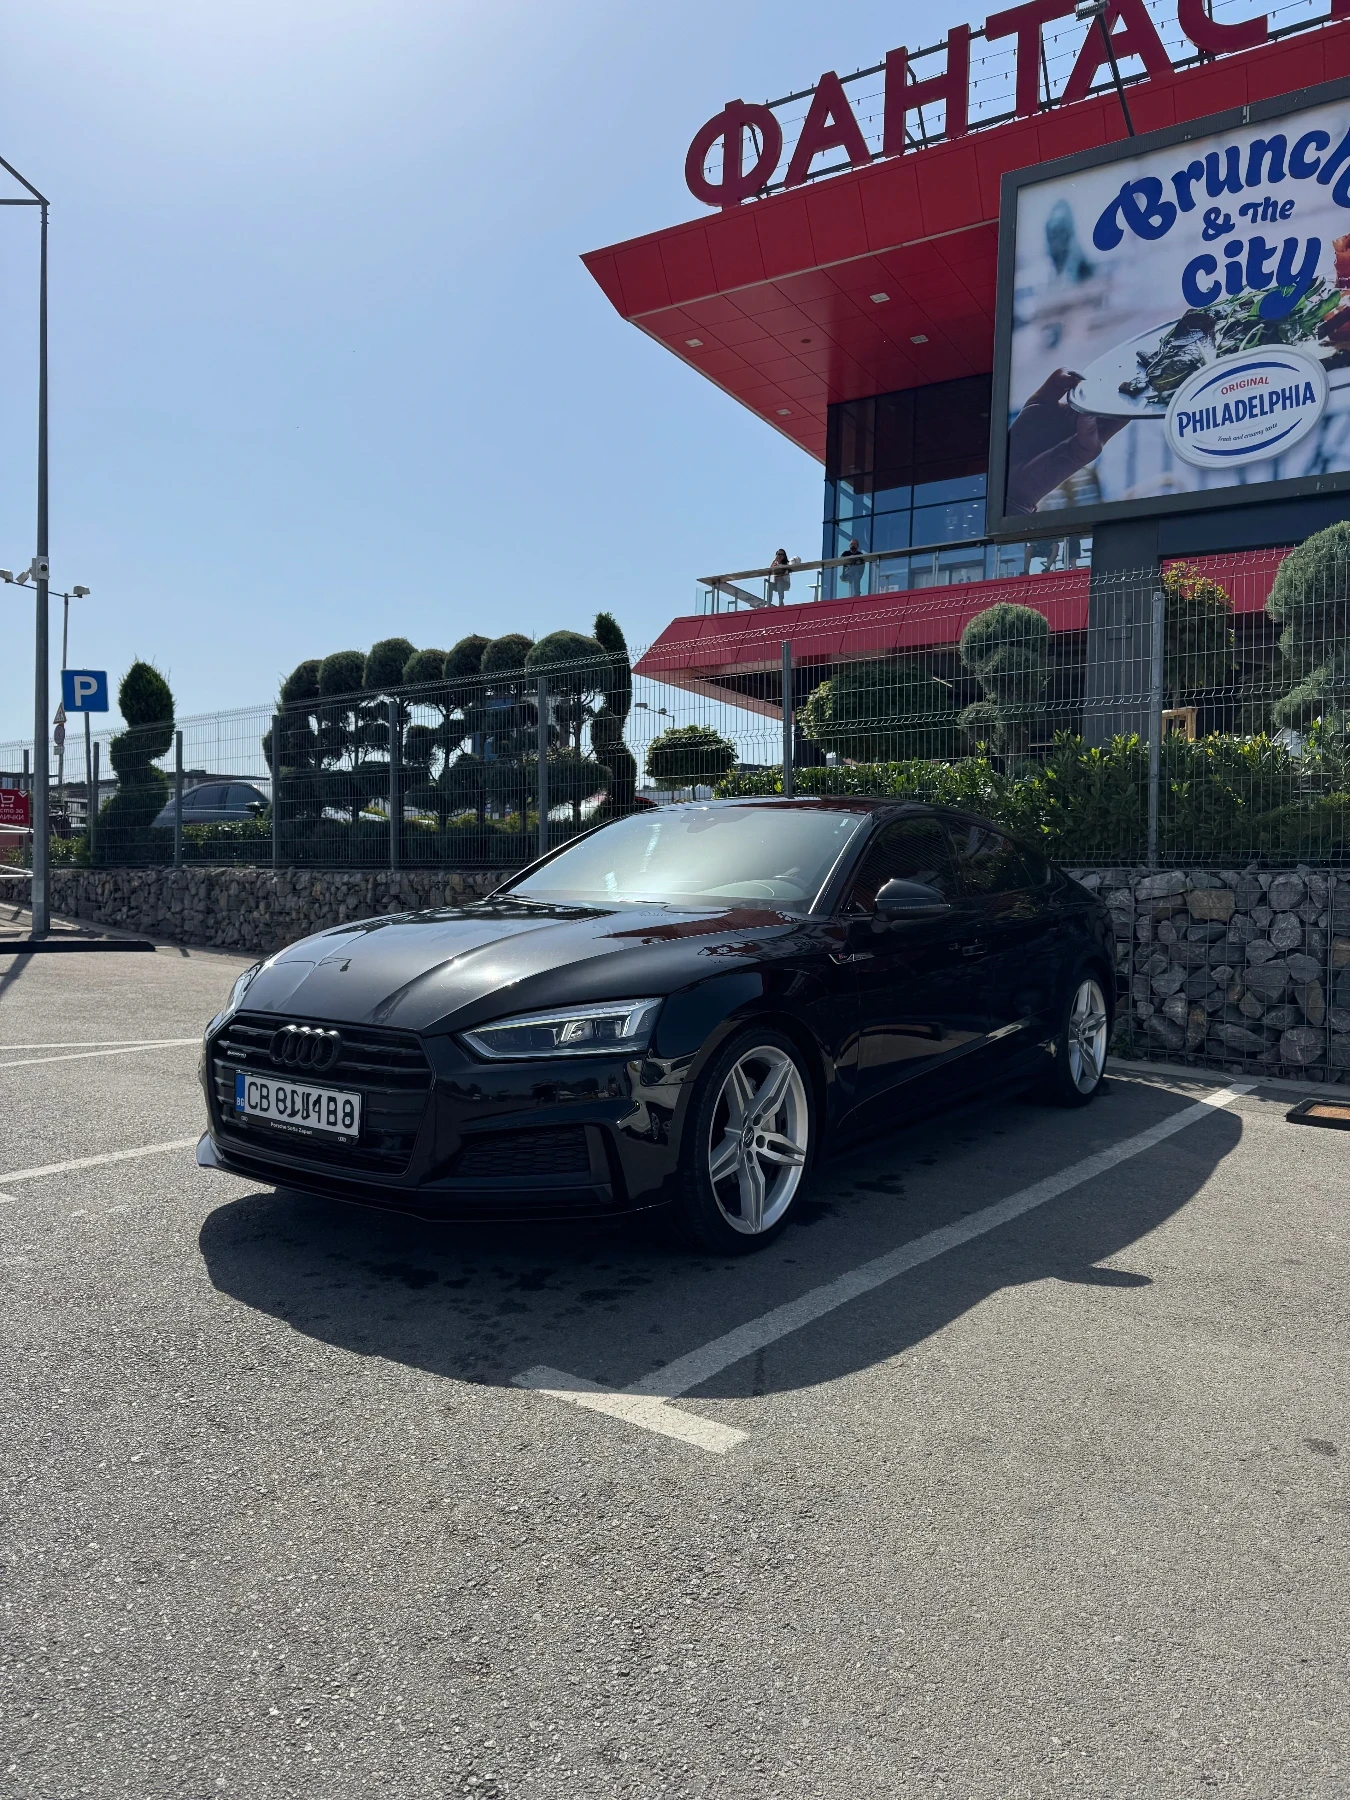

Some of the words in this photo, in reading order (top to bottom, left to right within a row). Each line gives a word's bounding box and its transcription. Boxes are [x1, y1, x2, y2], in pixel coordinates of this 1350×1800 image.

[684, 0, 1350, 210] ФАНТАС
[1201, 206, 1236, 242] &
[1238, 196, 1296, 224] The
[1220, 376, 1270, 396] ORIGINAL
[1176, 381, 1317, 438] PHILADELPHIA
[73, 675, 98, 707] P
[236, 1096, 245, 1107] BG
